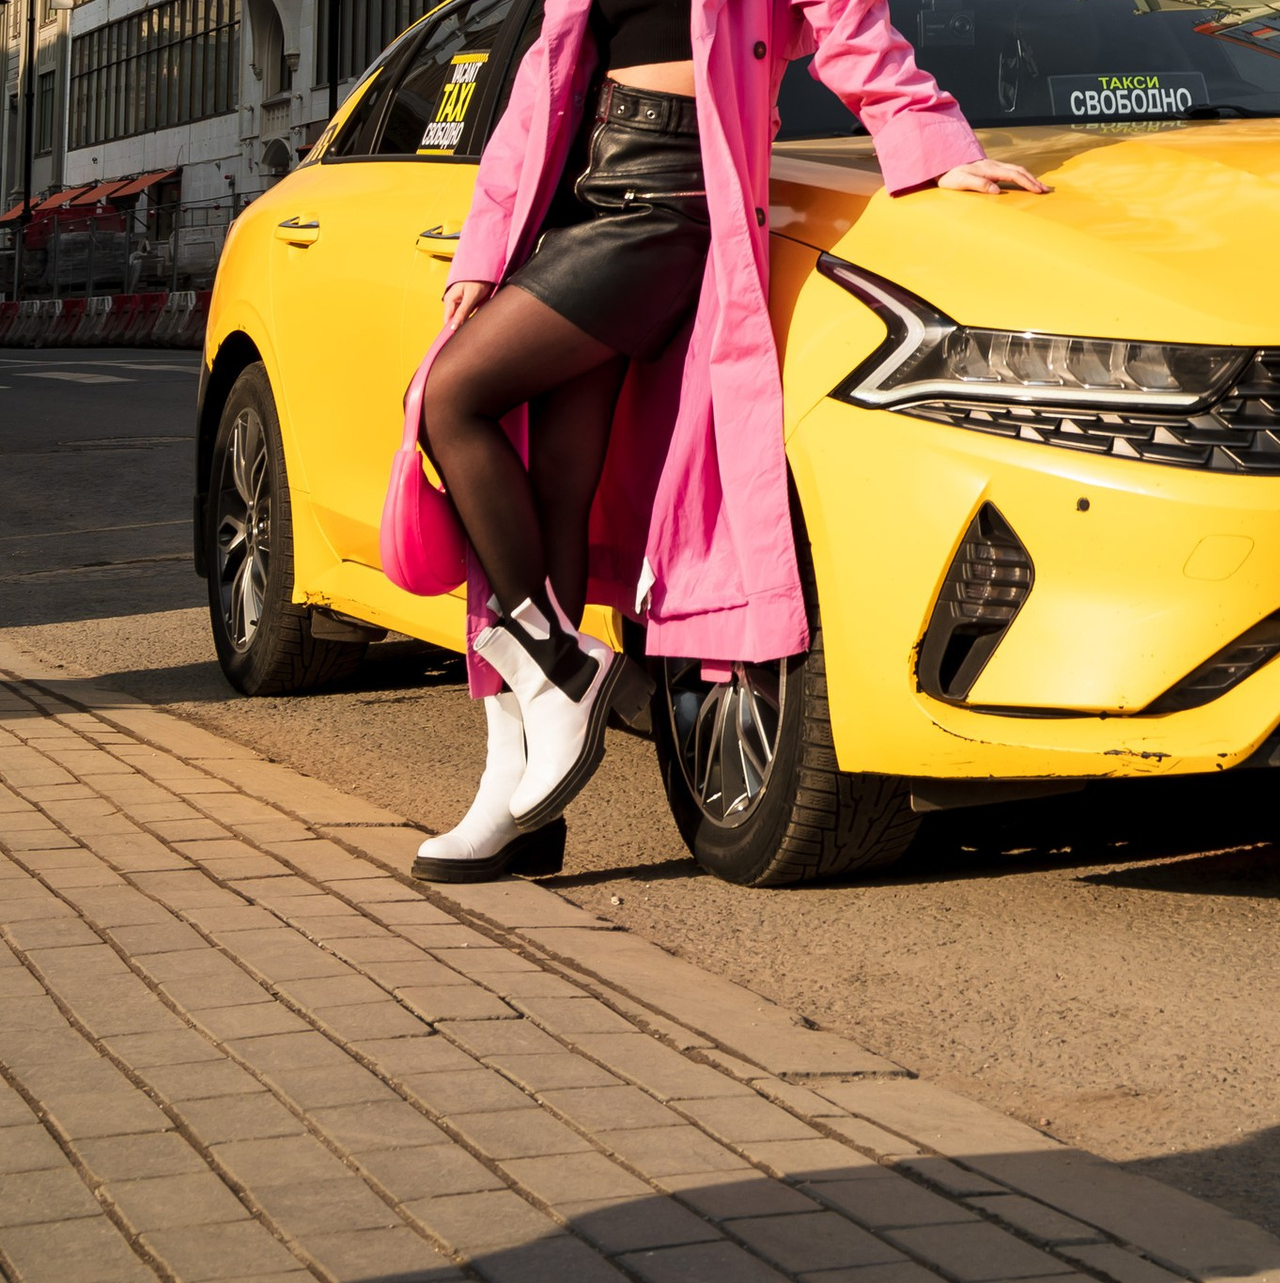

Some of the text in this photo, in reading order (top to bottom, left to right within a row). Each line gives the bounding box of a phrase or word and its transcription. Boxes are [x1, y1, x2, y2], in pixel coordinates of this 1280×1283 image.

[1098, 76, 1159, 90] ТАКСИ
[435, 82, 477, 122] TAXI
[1070, 87, 1192, 116] СВОБОДНО
[422, 122, 465, 149] СВОБОДНО
